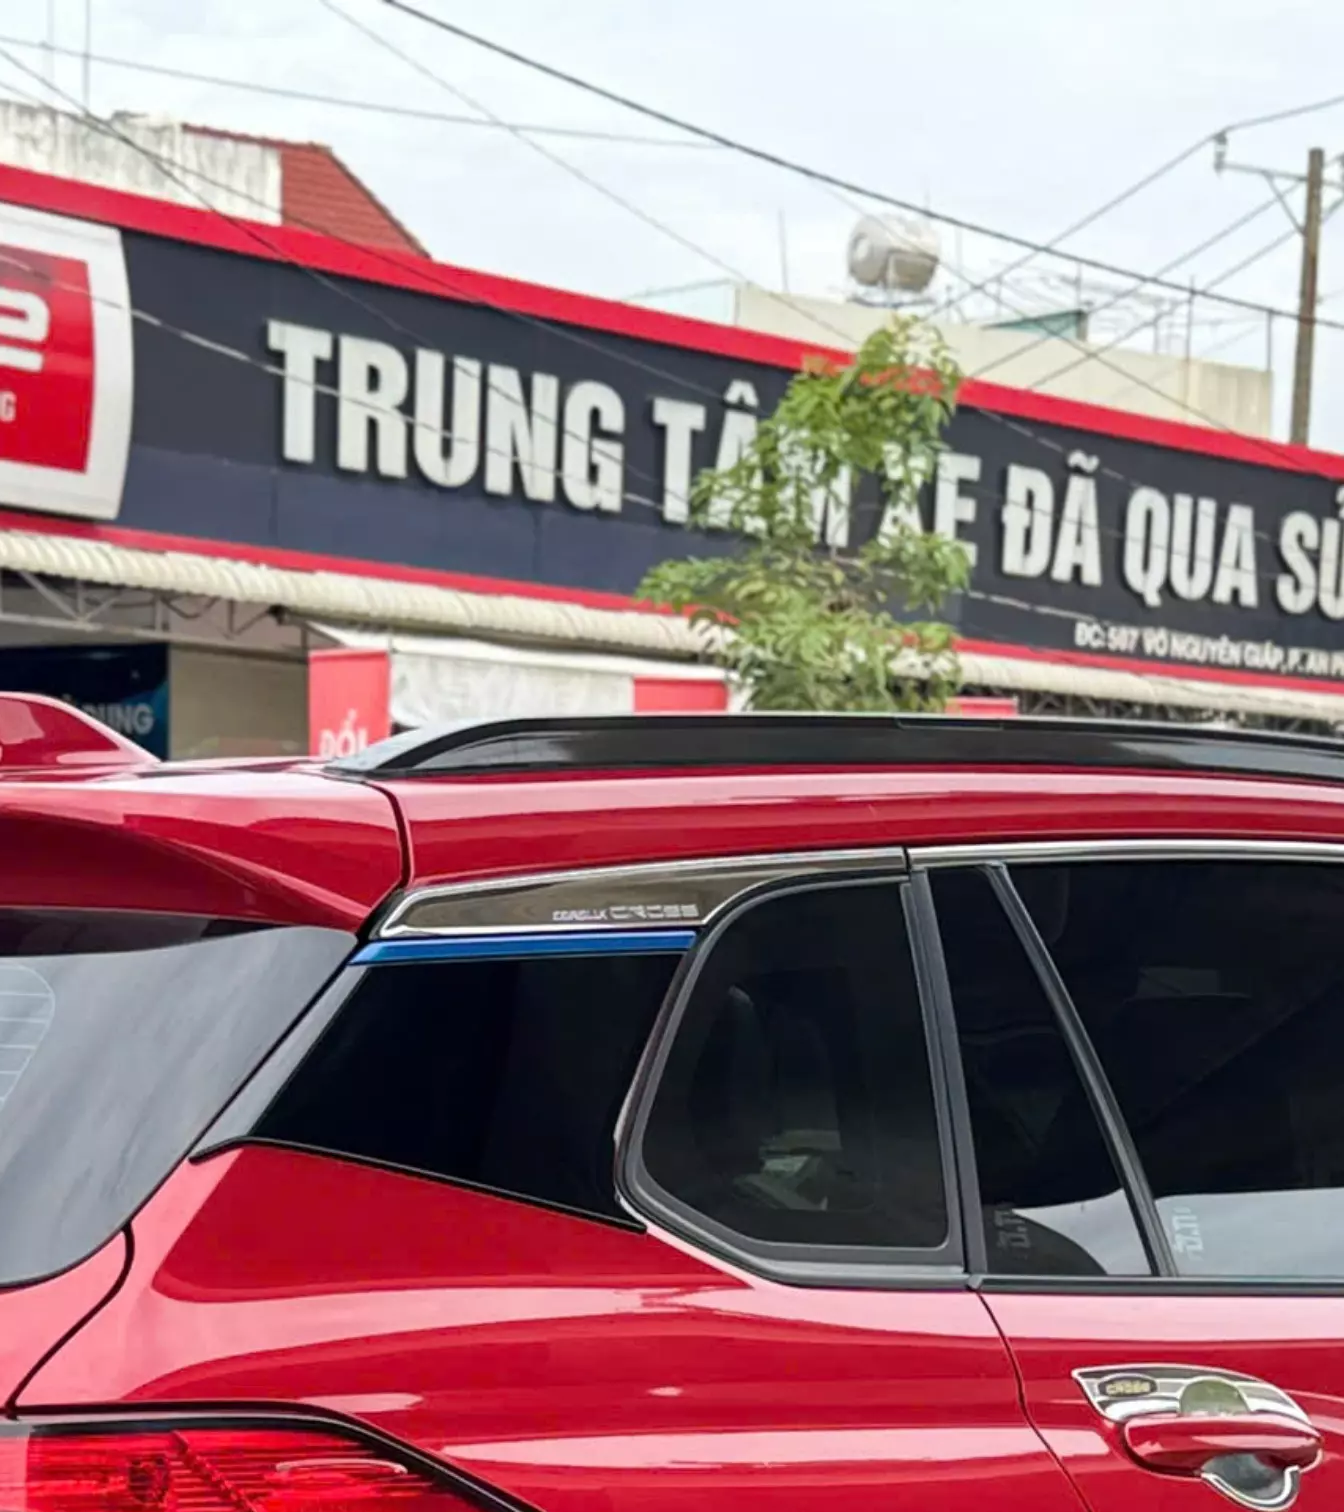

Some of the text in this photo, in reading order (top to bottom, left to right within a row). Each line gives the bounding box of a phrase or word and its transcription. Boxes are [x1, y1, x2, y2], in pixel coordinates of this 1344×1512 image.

[267, 319, 626, 512] TRUNG
[1002, 451, 1103, 587] ĐÃ
[1123, 486, 1258, 608] QUA
